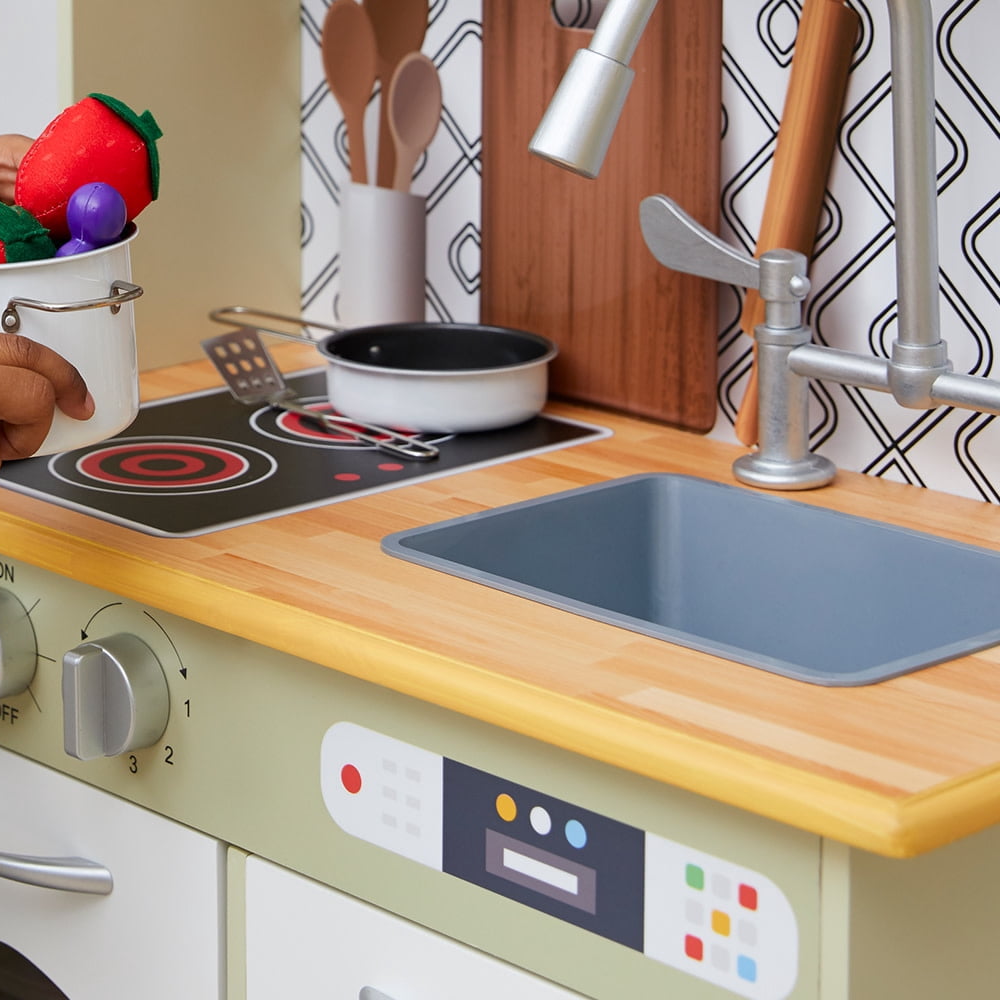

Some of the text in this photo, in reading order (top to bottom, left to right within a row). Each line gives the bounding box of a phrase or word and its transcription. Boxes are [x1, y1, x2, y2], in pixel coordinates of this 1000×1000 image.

[184, 699, 191, 718] 1
[129, 755, 138, 774] 3
[165, 745, 174, 765] 2
